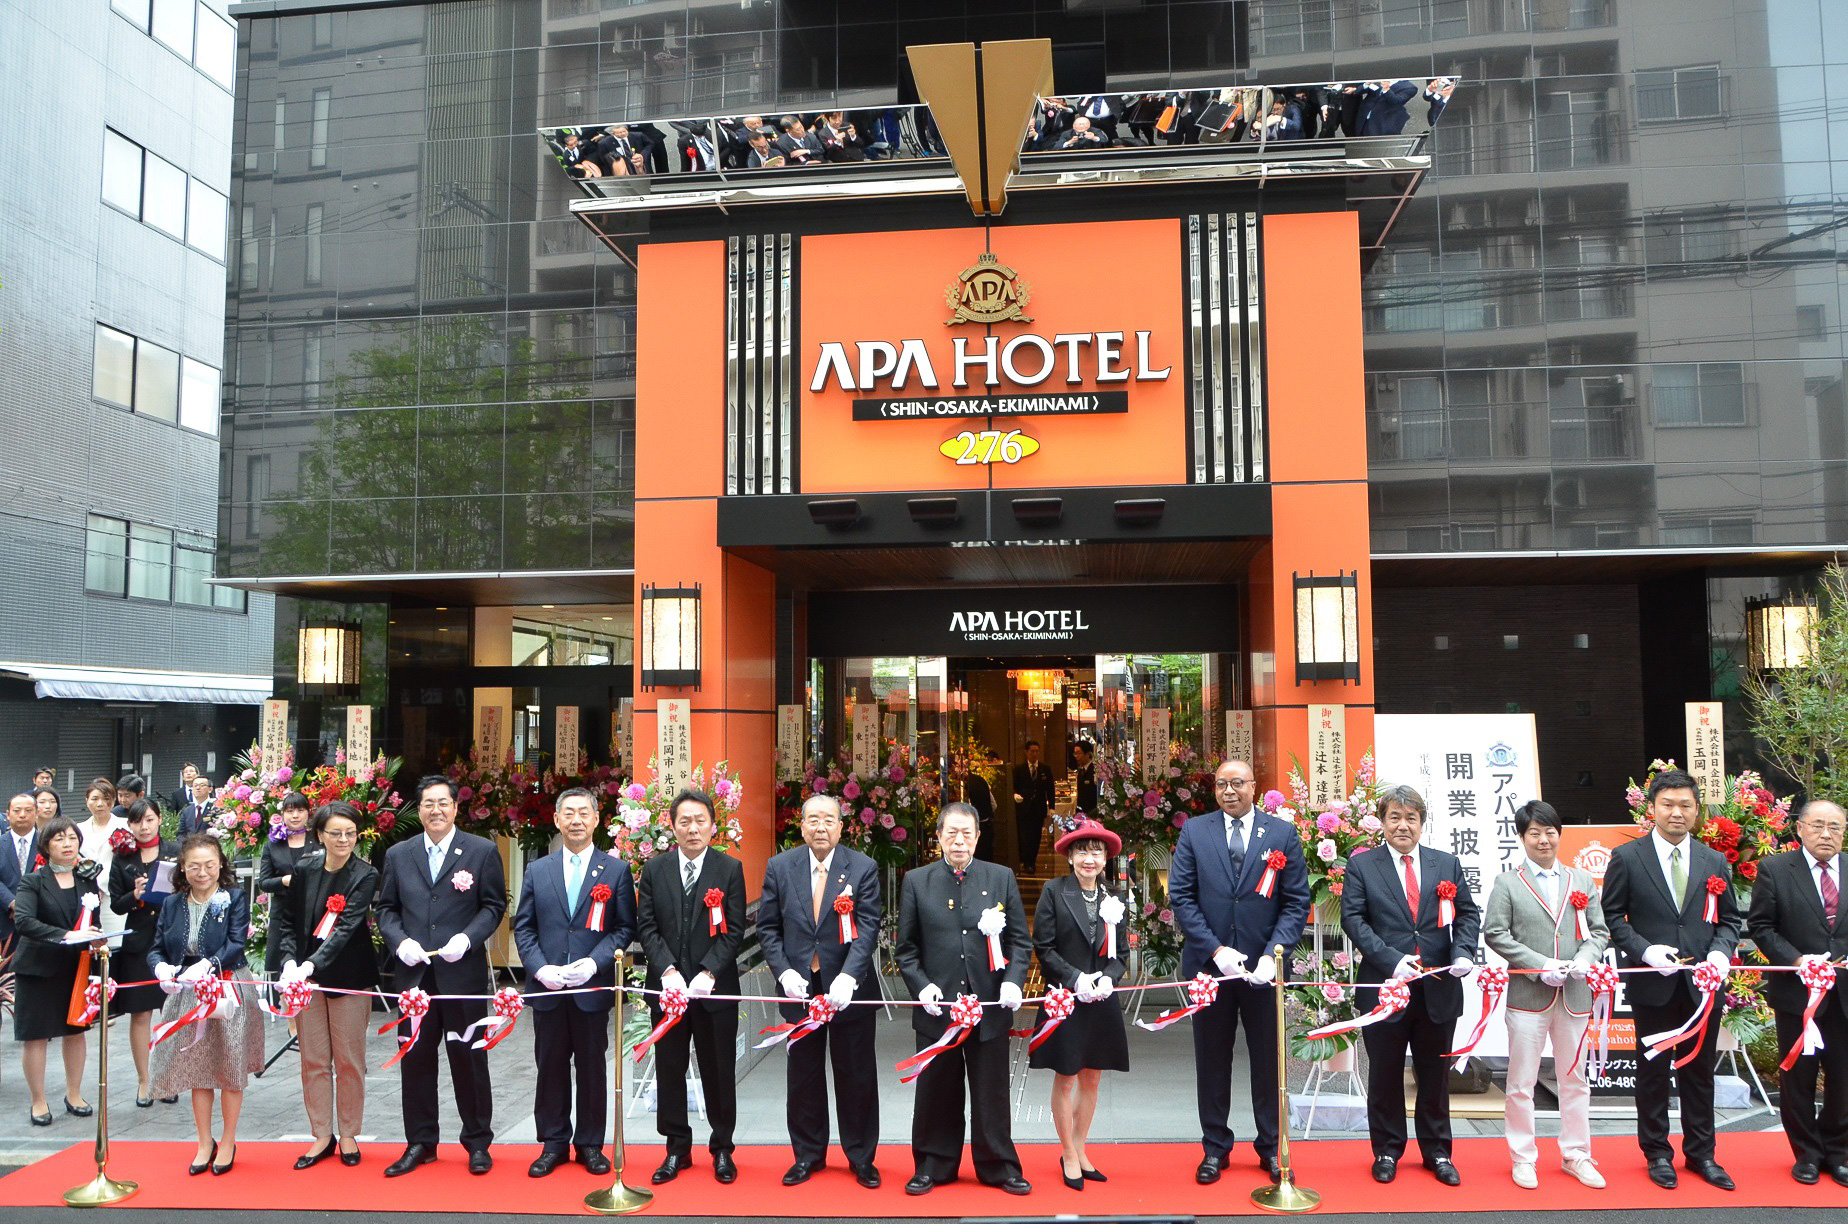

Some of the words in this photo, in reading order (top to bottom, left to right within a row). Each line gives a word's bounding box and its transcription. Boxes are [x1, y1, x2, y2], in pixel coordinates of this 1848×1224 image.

[961, 279, 1016, 303] APA
[809, 338, 939, 393] APA
[952, 330, 1171, 389] HOTEL
[956, 429, 1023, 465] 276
[949, 611, 999, 631] APA
[1004, 609, 1090, 631] HOTEL
[272, 702, 280, 719] 御祝
[355, 707, 363, 724] 御祝
[669, 702, 678, 722] 御祝
[786, 706, 795, 723] 御祝
[861, 706, 869, 722] 御祝
[1152, 710, 1160, 727] 御祝
[1235, 712, 1244, 729] 御祝
[1321, 707, 1332, 729] 御祝
[1699, 705, 1710, 726] 御祝
[663, 744, 675, 798] 岡市光司
[1709, 728, 1721, 798] 株式会社日企設計
